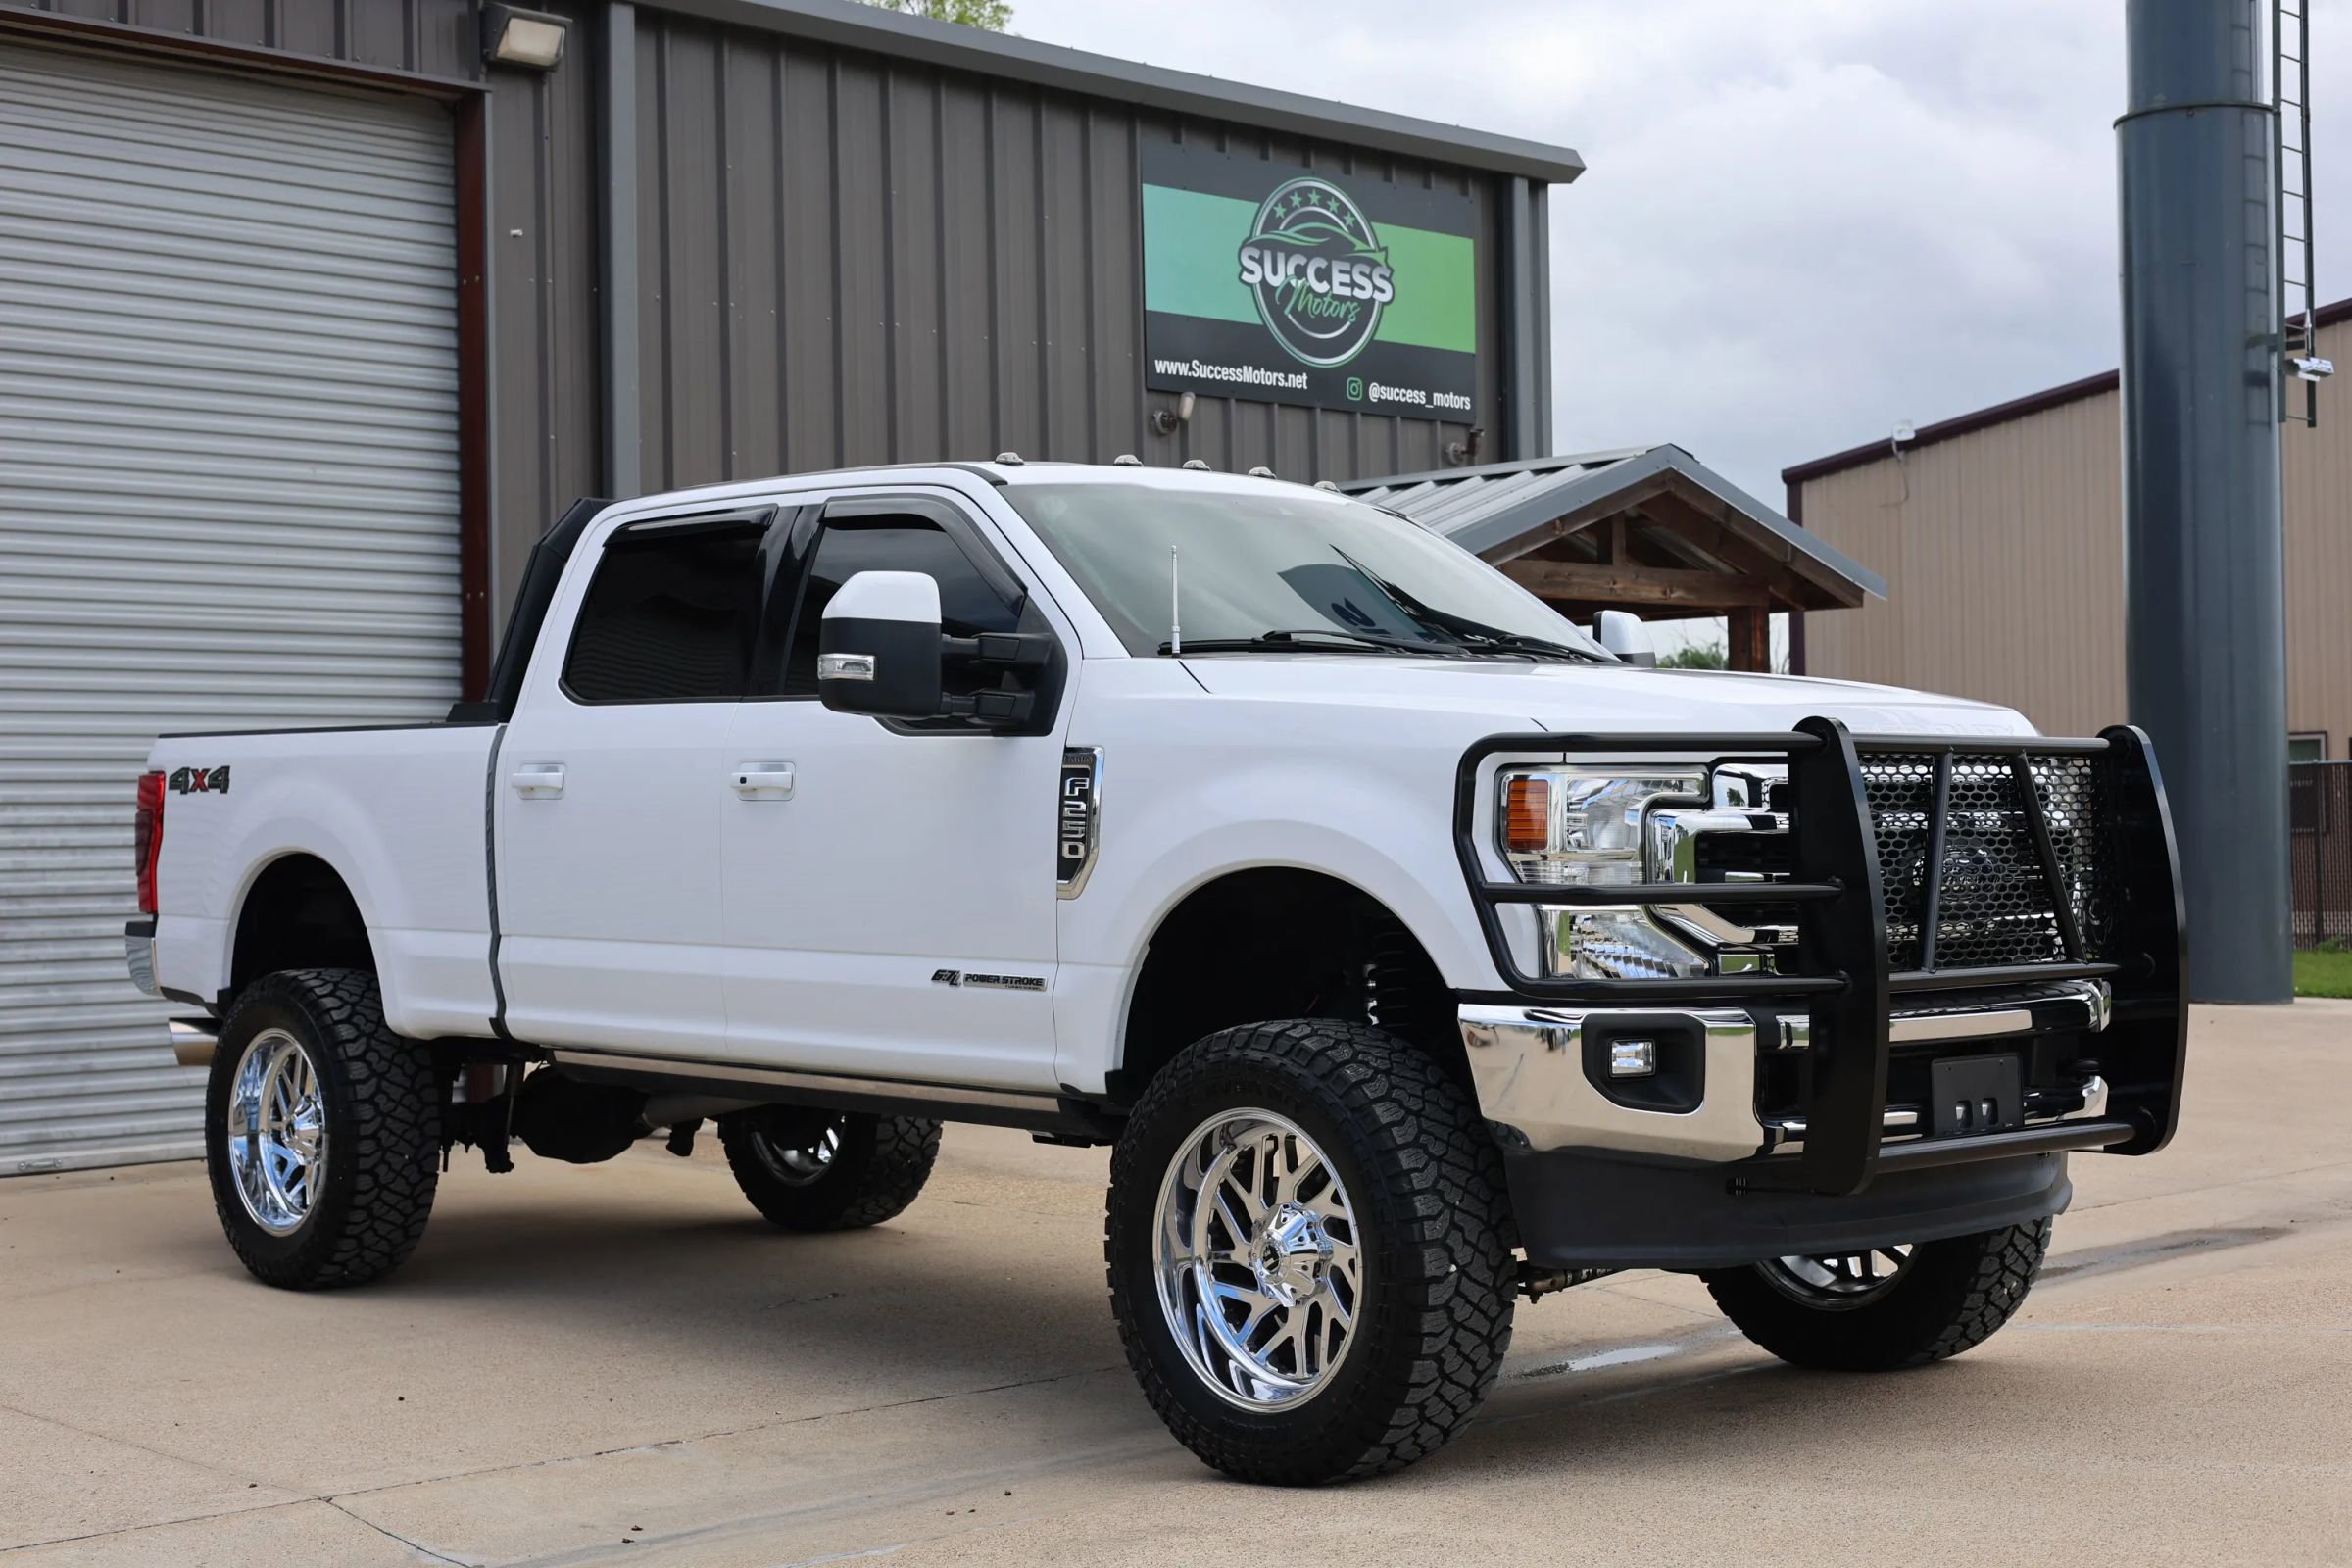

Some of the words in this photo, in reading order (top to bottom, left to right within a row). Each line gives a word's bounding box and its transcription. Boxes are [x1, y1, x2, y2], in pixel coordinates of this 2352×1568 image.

[1240, 246, 1394, 302] SUCCESS
[1275, 275, 1360, 322] Motors
[1154, 359, 1308, 390] www.SuccessMotors.net
[1368, 382, 1471, 410] @success_motors
[965, 973, 1000, 985] POWER
[1002, 976, 1044, 987] STROKE
